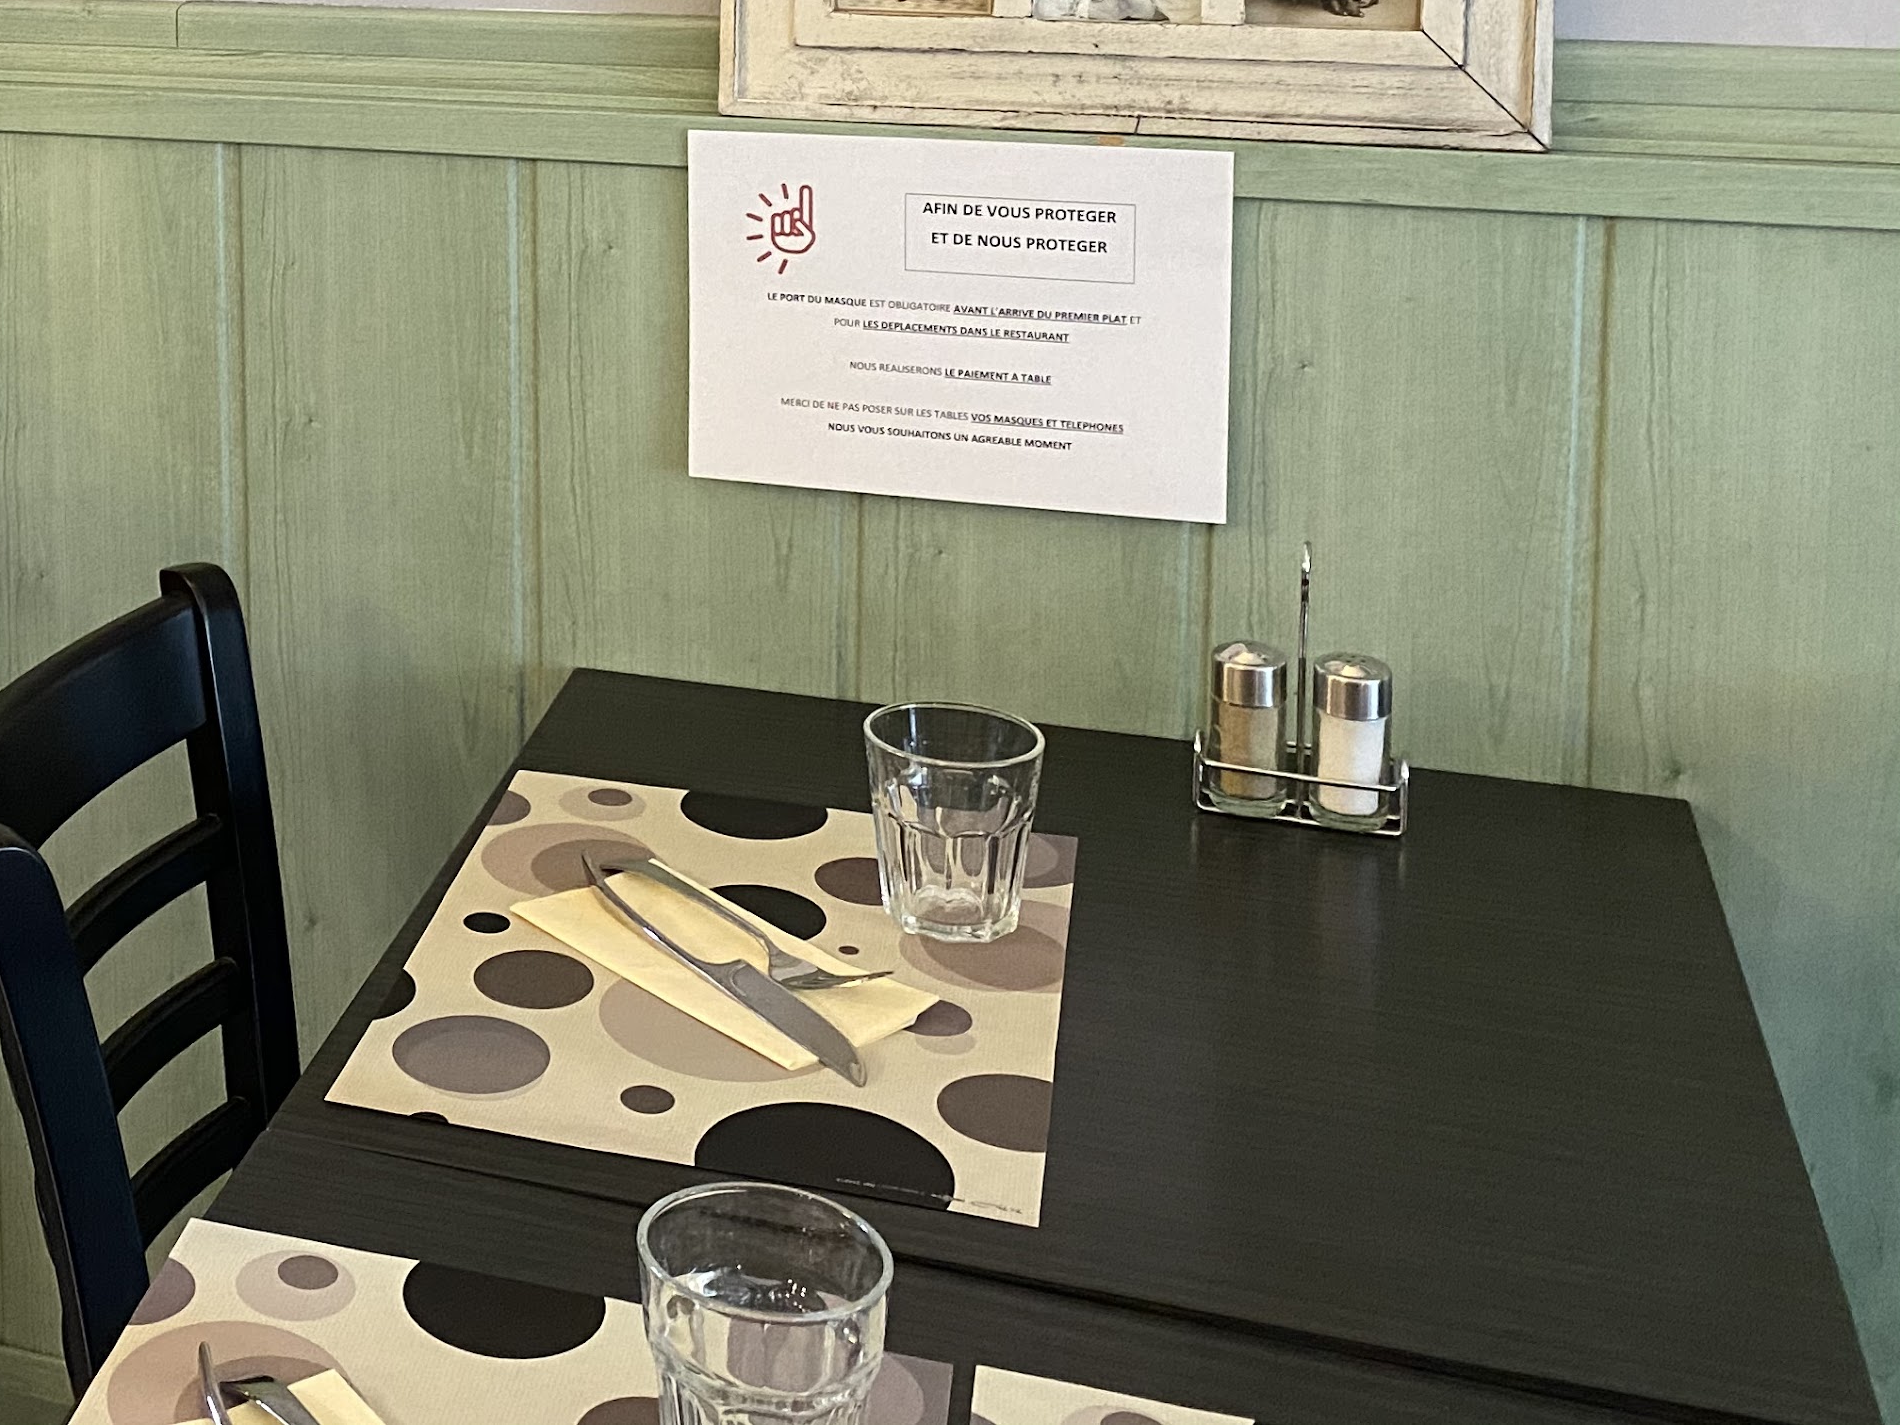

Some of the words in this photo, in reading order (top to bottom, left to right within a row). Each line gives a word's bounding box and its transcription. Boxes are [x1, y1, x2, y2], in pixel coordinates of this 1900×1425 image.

[922, 202, 958, 216] AFIN
[963, 204, 983, 217] DE
[987, 205, 1031, 219] VOUS
[1035, 207, 1117, 224] PROTEGER
[931, 232, 949, 245] ET
[953, 233, 973, 246] DE
[977, 235, 1021, 249] NOUS
[1026, 238, 1108, 254] PROTEGER
[767, 292, 778, 301] LE
[780, 293, 805, 302] PORT
[808, 295, 822, 304] DU
[825, 296, 867, 307] MASQUE
[870, 299, 886, 308] EST
[888, 300, 951, 313] OBLIGATOIRE
[953, 305, 989, 315] AVANT
[990, 306, 1035, 318] L'ARRIVE
[1037, 310, 1052, 320] DU
[1055, 311, 1100, 322] PREMIER
[1102, 314, 1128, 324] PLAT
[1130, 316, 1142, 325] ET
[834, 318, 861, 328] POUR
[863, 320, 879, 329] LES
[881, 321, 958, 335] DEPLACEMENTS
[960, 327, 988, 337] DANS
[990, 328, 1001, 337] LE
[1003, 330, 1070, 342] RESTAURANT
[849, 361, 877, 371] NOUS
[879, 363, 943, 376] REALISERONS
[945, 368, 956, 377] LE
[958, 369, 1008, 381] PAIEMENT
[1011, 372, 1019, 382] A
[1022, 373, 1052, 384] TABLE
[780, 397, 810, 408] MERCI
[812, 400, 825, 409] DE
[827, 401, 840, 410] NE
[843, 402, 860, 412] PAS
[862, 404, 893, 415] POSER
[894, 406, 914, 416] SUR
[916, 408, 932, 418] LES
[935, 410, 969, 421] TABLES
[971, 413, 992, 423] VOS
[994, 415, 1044, 427] MASQUES
[1046, 419, 1057, 428] ET
[1060, 420, 1124, 433] TELEPHONES
[828, 423, 855, 433] NOUS
[858, 425, 885, 435] VOUS
[887, 427, 952, 441] SOUHAITONS
[954, 432, 969, 442] UN
[971, 435, 1022, 447] AGREABLE
[1024, 439, 1073, 451] MOMENT
